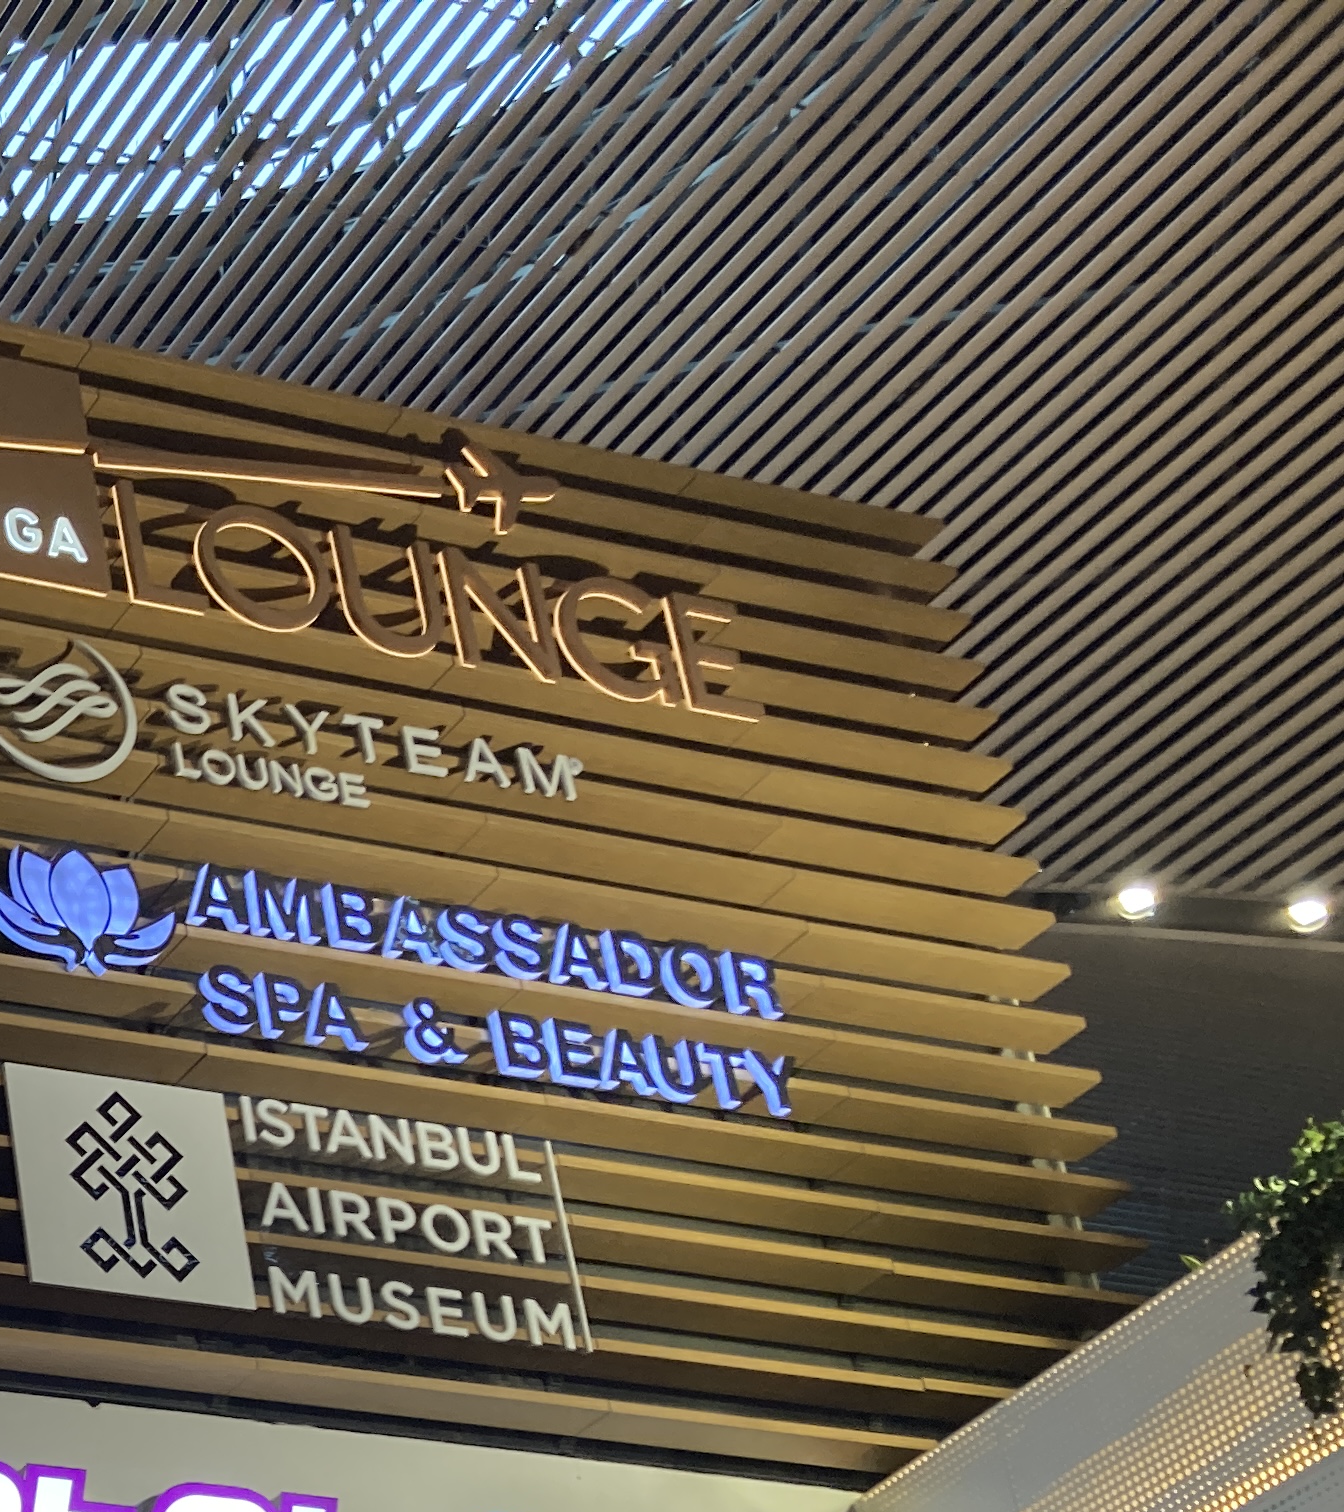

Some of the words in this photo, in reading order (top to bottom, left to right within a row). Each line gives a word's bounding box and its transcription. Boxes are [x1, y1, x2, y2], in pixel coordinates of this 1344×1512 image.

[112, 481, 761, 724] LOUNGE
[166, 683, 578, 801] SKYTEAM
[171, 741, 372, 809] LOUNGE
[185, 862, 787, 1021] AMBASSADOR
[198, 968, 372, 1052] SPA
[403, 999, 469, 1065] &
[486, 1007, 796, 1119] BEAUTY
[238, 1095, 543, 1185] ISTANBUL
[260, 1181, 553, 1266] AIRPORT
[268, 1263, 579, 1352] MUSEUM
